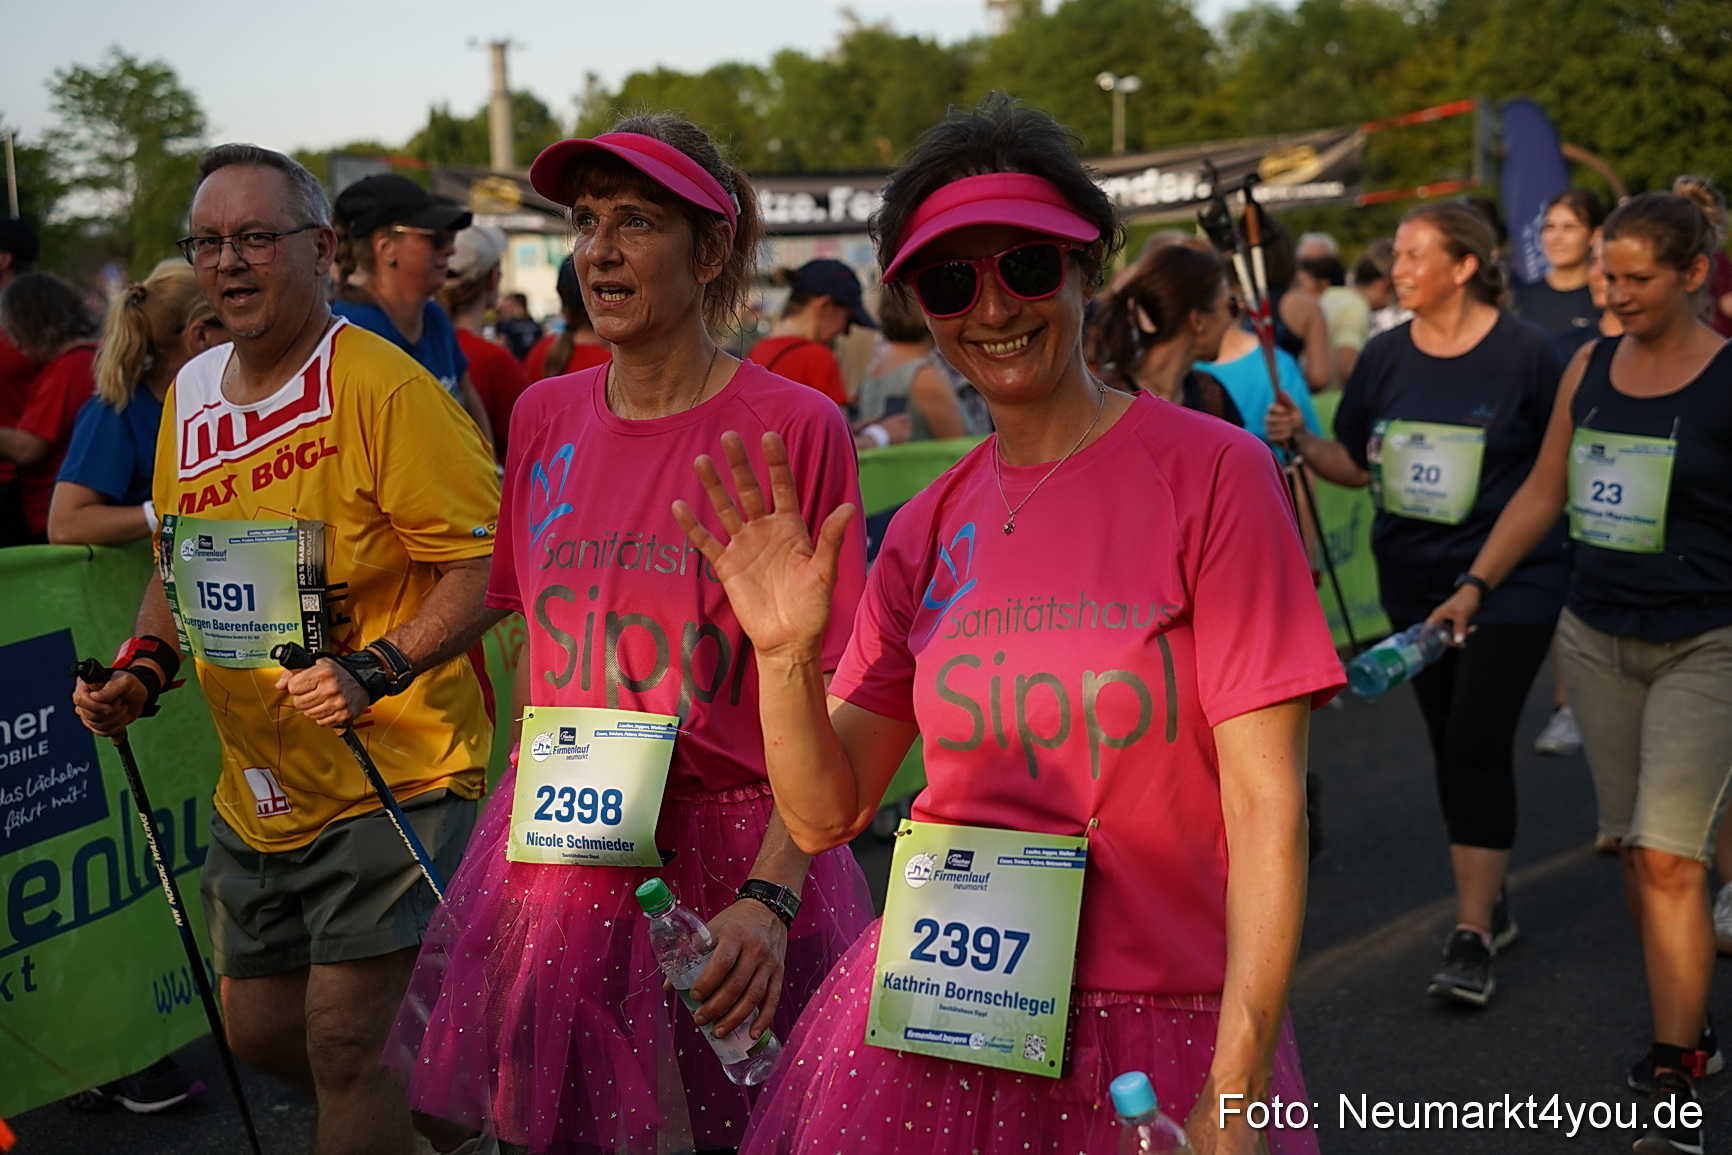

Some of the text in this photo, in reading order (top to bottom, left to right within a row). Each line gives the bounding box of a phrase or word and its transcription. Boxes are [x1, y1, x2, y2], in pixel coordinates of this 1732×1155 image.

[179, 436, 338, 515] MAX BÖGL
[1411, 463, 1440, 485] 20
[1592, 480, 1622, 505] 23
[162, 526, 174, 534] AOK
[195, 549, 227, 557] Firmenlauf
[299, 573, 306, 586] 20
[196, 581, 255, 612] 1591
[944, 590, 1181, 640] Sanitätshaus
[213, 620, 299, 634] Baerenfaenger
[535, 585, 750, 722] Sippl
[935, 633, 1178, 780] Sippl
[553, 744, 590, 755] Firmenlauf
[534, 785, 623, 826] 2398
[138, 811, 161, 861] WALKING
[526, 832, 635, 851] Nicole Schmieder
[156, 862, 176, 905] NORDIC
[934, 870, 991, 884] Firmenlauf
[954, 884, 988, 892] neumarkt
[909, 918, 1030, 975] 2397
[883, 972, 1056, 1016] Kathrin Bornschlegel
[939, 1004, 988, 1018] Sanitätshaus Sippl
[906, 1030, 968, 1044] firmenlauf.bayern
